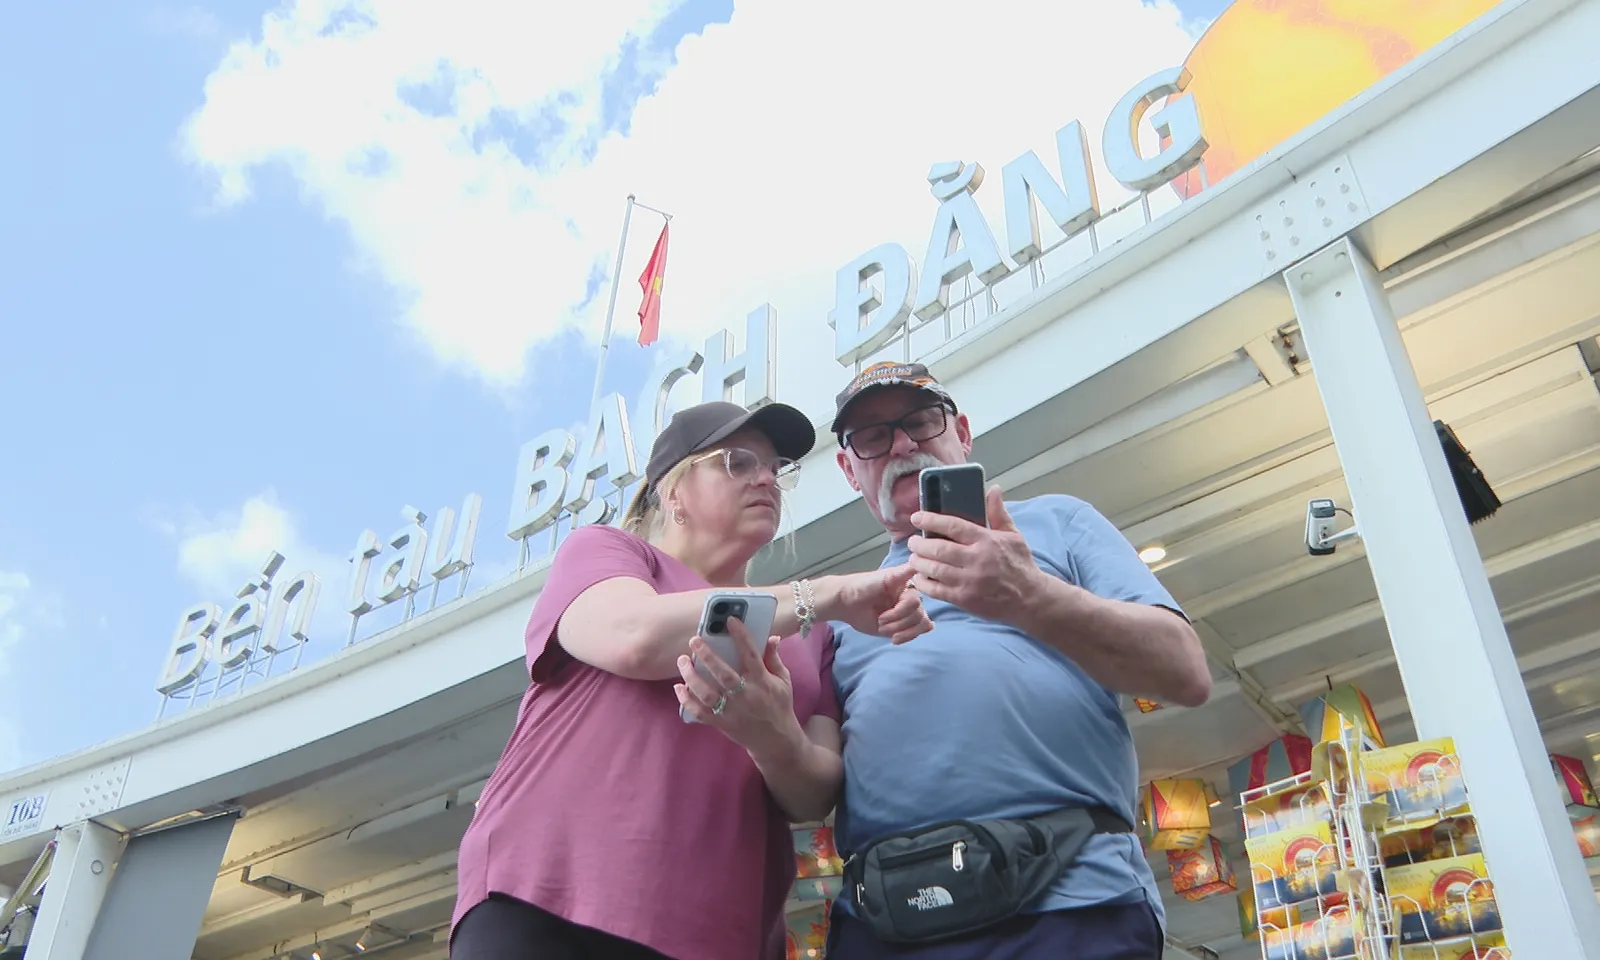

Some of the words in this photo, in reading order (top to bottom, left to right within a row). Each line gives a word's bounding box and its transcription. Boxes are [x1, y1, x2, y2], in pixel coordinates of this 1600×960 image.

[157, 551, 321, 695] Bến
[345, 492, 482, 617] tàu
[827, 66, 1209, 367] ĐẰNG
[907, 893, 938, 907] NORTH
